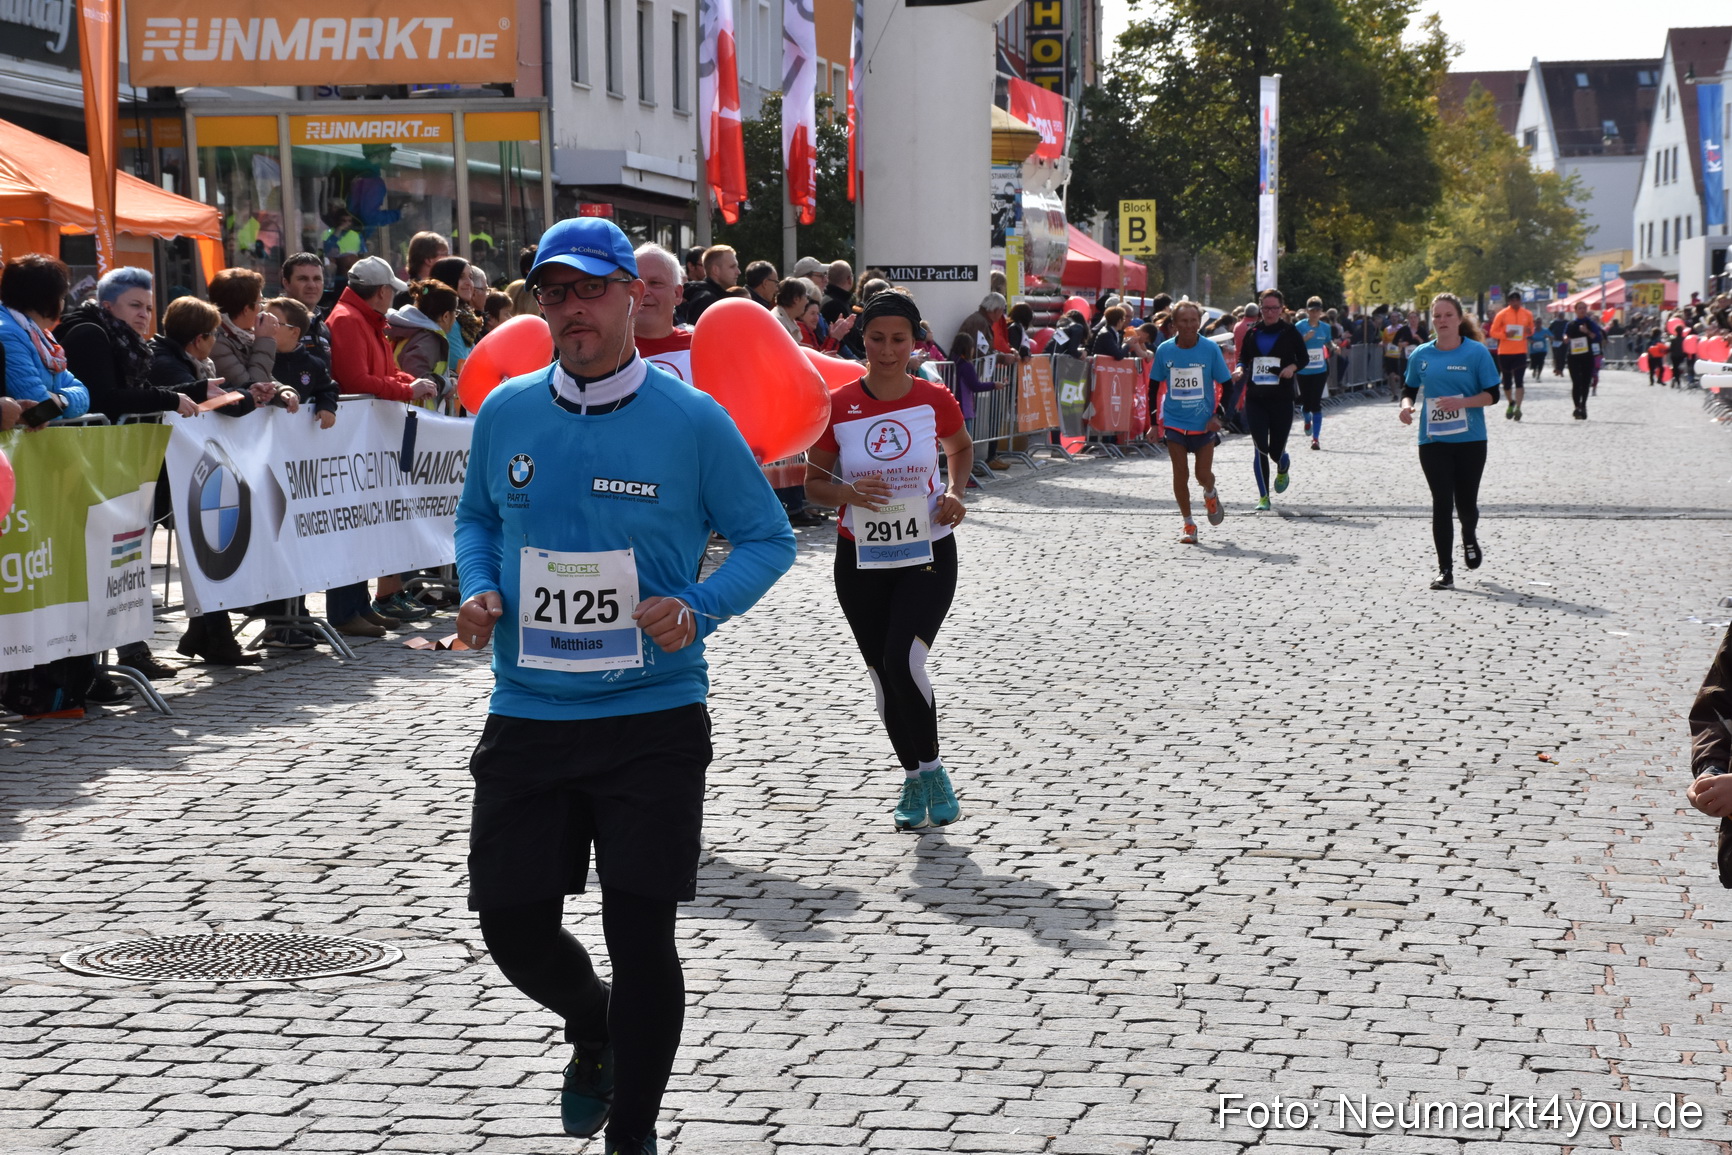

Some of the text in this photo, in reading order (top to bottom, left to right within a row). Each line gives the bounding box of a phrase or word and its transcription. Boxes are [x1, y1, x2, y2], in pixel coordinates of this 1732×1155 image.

[142, 17, 498, 62] RUNMARKT.DE
[306, 120, 440, 139] RUNMARKT.DE
[1123, 202, 1152, 213] Block
[1129, 217, 1147, 244] B
[577, 246, 609, 257] Columbia
[1370, 279, 1381, 295] C
[1420, 294, 1429, 306] D
[1256, 365, 1271, 375] 249
[1174, 377, 1199, 388] 2316
[1431, 409, 1460, 421] 2930
[510, 454, 534, 467] BMW
[284, 458, 319, 500] BMW
[593, 478, 657, 497] BOCK
[507, 493, 531, 503] PARTL
[506, 502, 531, 510] Neumarkt
[864, 517, 919, 542] 2914
[557, 564, 599, 574] BOCK
[534, 586, 620, 625] 2125
[550, 636, 604, 651] Matthias
